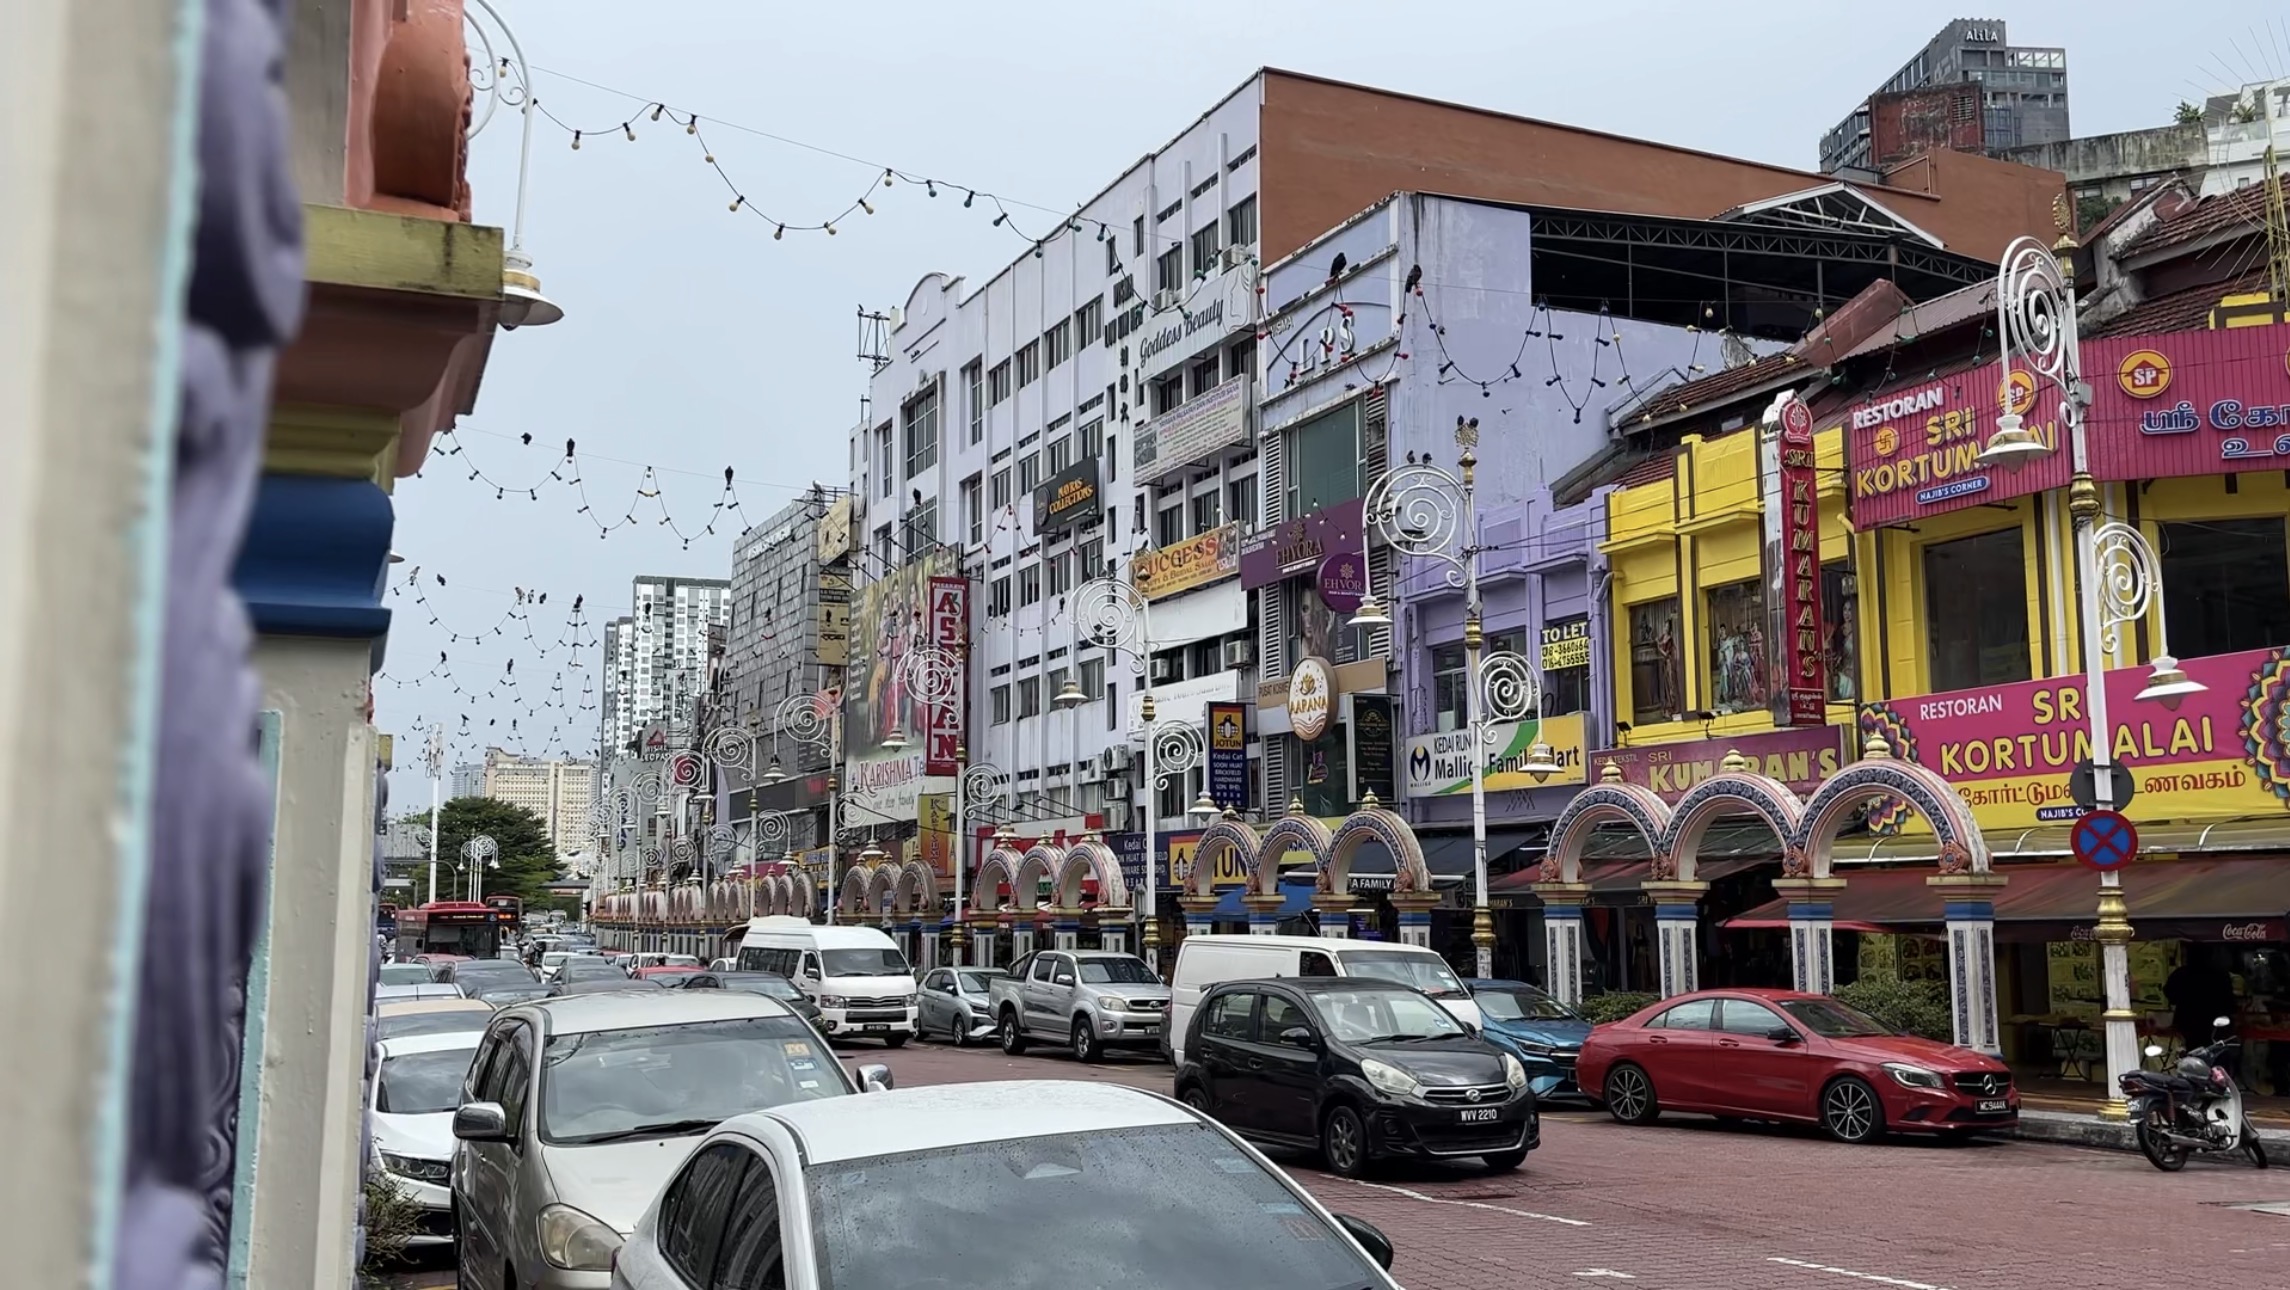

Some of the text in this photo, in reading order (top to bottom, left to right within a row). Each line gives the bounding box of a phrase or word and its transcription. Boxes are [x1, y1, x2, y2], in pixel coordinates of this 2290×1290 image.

[1141, 323, 1182, 369] Goddess
[1184, 299, 1223, 338] Beauty
[1299, 313, 1356, 377] LPS
[2133, 367, 2157, 387] SP
[1853, 386, 1944, 430] RESTORAN
[1925, 404, 1976, 447] SRI
[1785, 449, 1814, 468] SRI
[1856, 419, 2058, 499] KORTUMAI
[1919, 479, 1983, 502] NAJIB'S CORNER
[1139, 536, 1218, 577] UCCESS
[1324, 577, 1362, 591] EHVOR
[1792, 479, 1823, 678] KUMARAN'S
[1541, 621, 1588, 643] TO LET
[1272, 680, 1289, 696] KOSME
[1289, 696, 1328, 715] AAPANA
[1920, 694, 2003, 721] RESTORAN
[1215, 739, 1242, 748] JOTUN
[1433, 732, 1473, 755] KEDAI RUN
[1213, 752, 1243, 761] Kedai Cat
[1647, 750, 1672, 763] SRI
[860, 756, 913, 798] KARISHMA
[1434, 755, 1475, 782] Mallig
[1650, 747, 1838, 794] KUMRAN'S
[2039, 807, 2073, 820] NAJIB'S
[1123, 838, 1142, 850] Kedai
[1360, 878, 1392, 889] FAMILY
[1460, 1108, 1498, 1122] WVV 2210
